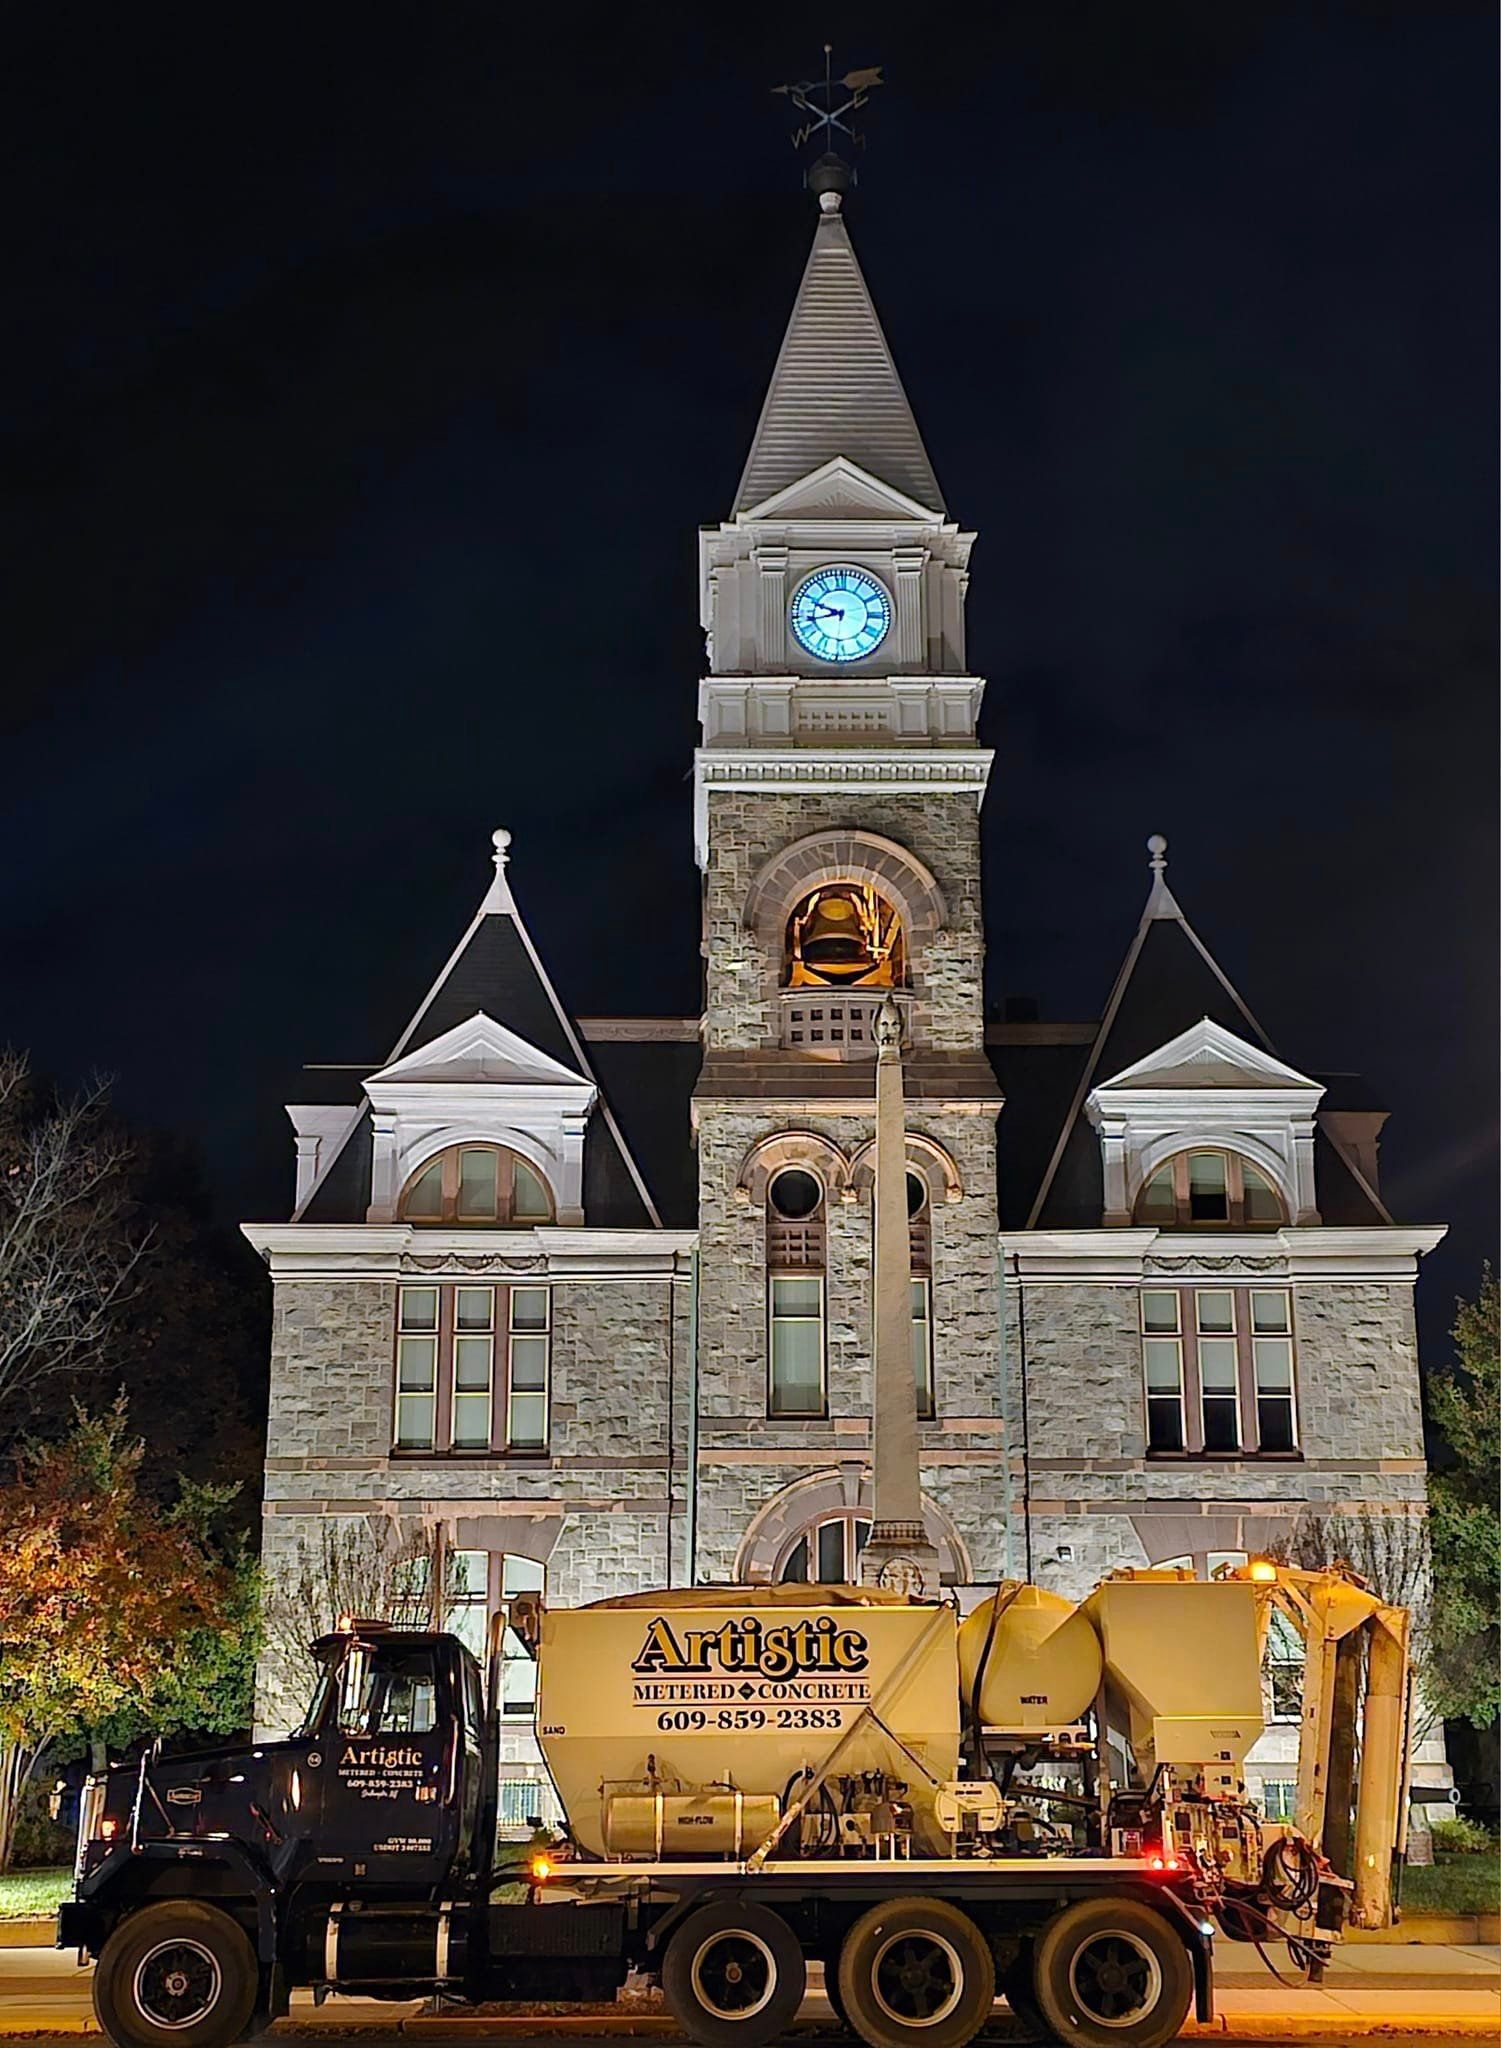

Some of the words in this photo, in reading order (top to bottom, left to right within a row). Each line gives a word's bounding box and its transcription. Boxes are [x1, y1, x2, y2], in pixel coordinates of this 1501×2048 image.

[631, 1616, 870, 1682] Artistic
[634, 1684, 735, 1700] METERED
[758, 1683, 872, 1699] CONCRETE
[1019, 1695, 1048, 1705] WATER
[657, 1709, 842, 1730] 609-859-2383
[543, 1726, 566, 1735] SAND
[340, 1746, 423, 1768] Artistic
